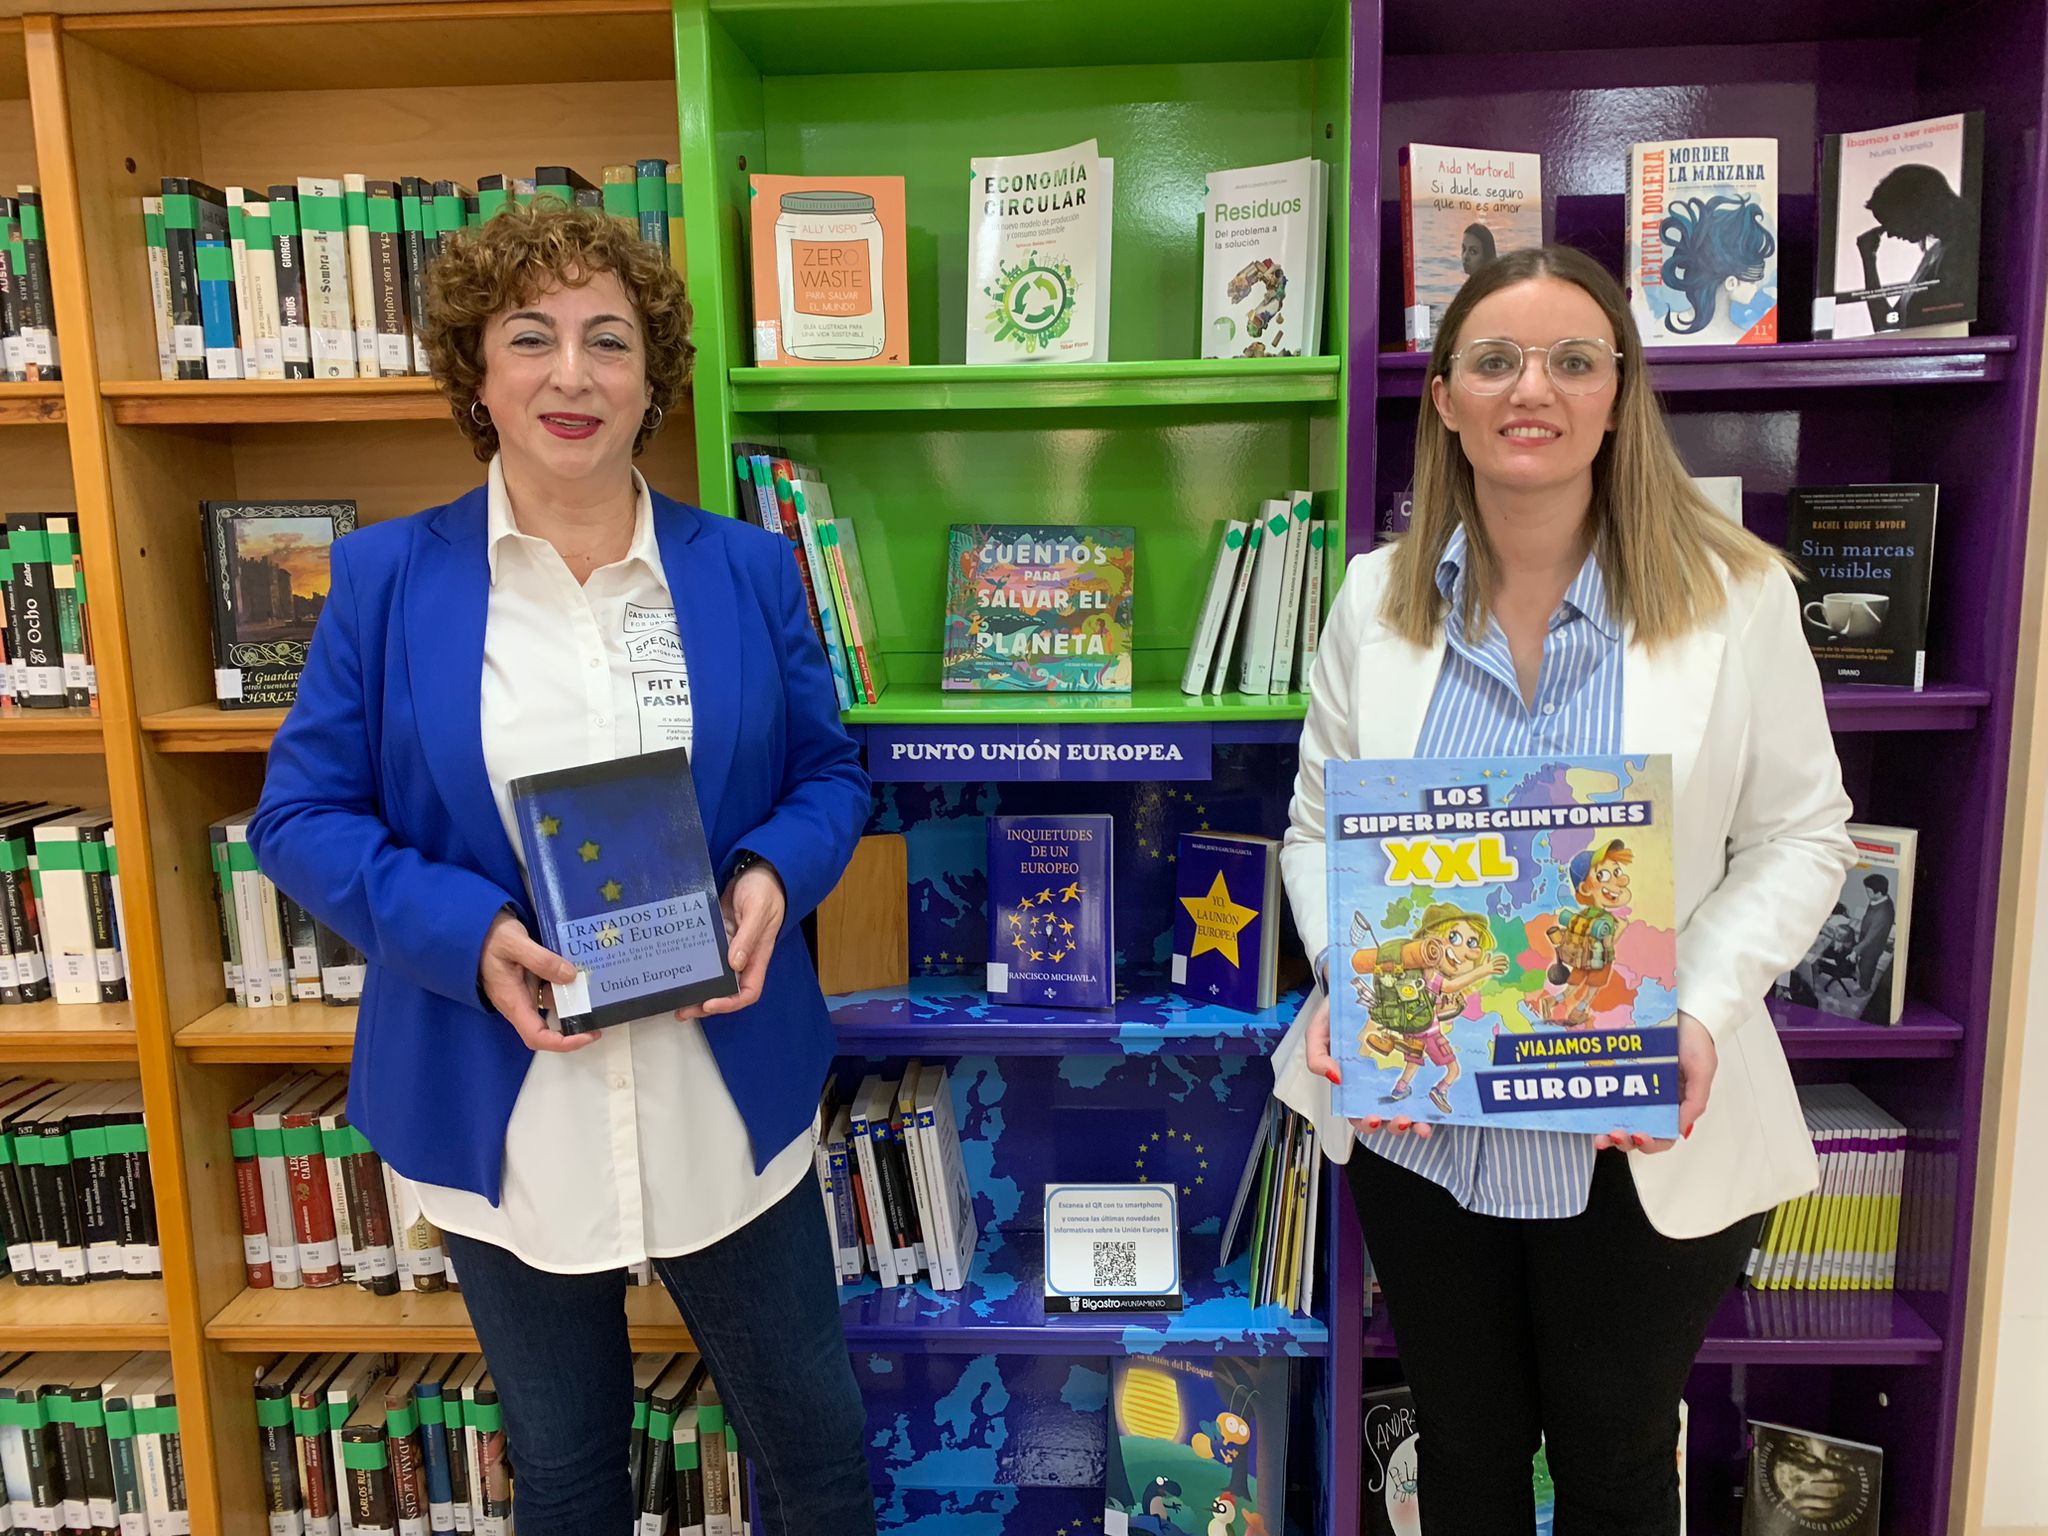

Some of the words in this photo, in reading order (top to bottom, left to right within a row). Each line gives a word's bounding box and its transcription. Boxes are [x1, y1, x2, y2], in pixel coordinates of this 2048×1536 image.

[1892, 133, 1901, 141] a
[1903, 129, 1921, 139] ser
[1923, 122, 1959, 134] reinas
[1669, 146, 1730, 165] MORDER
[1899, 141, 1934, 153] Varela
[1438, 158, 1462, 175] Aida
[1467, 162, 1515, 179] Martorell
[1669, 166, 1688, 183] LA
[1692, 164, 1766, 182] MANZANA
[985, 162, 1087, 194] ECONOMÍA
[1641, 150, 1665, 216] DOLERA
[1431, 179, 1444, 194] Si
[1485, 190, 1524, 201] seguro
[984, 187, 1086, 217] CIRCULAR
[1215, 197, 1302, 223] Residuos
[1434, 199, 1455, 213] que
[1459, 200, 1472, 211] no
[1476, 203, 1489, 212] es
[1493, 203, 1522, 213] amor
[802, 224, 825, 233] ALLY
[828, 224, 857, 233] VISPO
[1020, 219, 1041, 228] modelo
[1042, 218, 1050, 226] de
[1051, 214, 1080, 227] producción
[1011, 230, 1037, 239] consumo
[1038, 226, 1065, 237] sostenible
[1215, 229, 1229, 239] Del
[1231, 225, 1270, 239] problema
[1215, 241, 1223, 250] la
[1224, 238, 1260, 249] solución
[1641, 218, 1664, 287] LETICIA
[382, 252, 391, 266] DE
[803, 249, 860, 266] ZERO
[319, 253, 332, 293] Sombra
[383, 268, 393, 284] LOS
[801, 271, 863, 288] WASTE
[806, 292, 826, 300] PARA
[828, 292, 858, 300] SALVAR
[286, 296, 296, 317] DIOS
[809, 303, 820, 312] EL
[822, 303, 856, 311] MUNDO
[1812, 520, 1840, 530] RACHEL
[1844, 520, 1871, 530] LOUISE
[1875, 520, 1907, 530] SNYDER
[979, 544, 1108, 565] CUENTOS
[1801, 539, 1834, 557] Sin
[1842, 544, 1915, 558] marcas
[1024, 571, 1061, 582] PARA
[1819, 562, 1893, 580] visibles
[977, 588, 1070, 609] SALVAR
[1079, 590, 1108, 610] EL
[23, 598, 42, 644] Ocho
[628, 610, 661, 619] CASUAL
[976, 632, 1105, 655] PLANETA
[30, 649, 47, 664] El
[240, 672, 253, 683] El
[648, 679, 673, 691] FIT
[643, 694, 689, 707] FASH
[891, 743, 975, 760] PUNTO
[981, 739, 1061, 761] UNIÓN
[1067, 744, 1183, 761] EUROPEA
[1433, 787, 1483, 806] LOS
[1343, 804, 1645, 835] SUPERPREGUNTONES
[1007, 829, 1093, 843] INQUIETUDES
[1031, 846, 1047, 857] DE
[1050, 846, 1069, 857] UN
[1385, 837, 1513, 883] XXL
[1021, 862, 1079, 874] EUROPEO
[7, 884, 16, 907] Muerte
[14, 926, 23, 946] Fenice
[566, 910, 652, 938] TRATADOS
[657, 904, 678, 918] DE
[682, 899, 703, 913] LA
[1197, 909, 1208, 919] LA
[1209, 911, 1239, 925] UNIÓN
[567, 933, 625, 956] UNIÓN
[630, 915, 706, 942] EUROPEA
[1197, 925, 1237, 941] EUROPEA
[600, 975, 640, 993] Unión
[642, 964, 692, 983] Europea
[1051, 973, 1097, 983] MICHAVILA
[1515, 1037, 1602, 1063] ¡VIAJAMOS
[1606, 1035, 1642, 1052] POR
[1492, 1073, 1660, 1101] EUROPA!
[43, 1126, 60, 1135] 408
[1058, 1201, 1084, 1209] Escanea
[1085, 1201, 1092, 1209] el
[1125, 1202, 1163, 1210] smartphone
[1142, 1227, 1169, 1235] Europea
[1082, 1298, 1121, 1310] Bigastro
[1120, 1299, 1166, 1307] AYUNTAMIENTO
[1171, 1359, 1184, 1371] del
[1186, 1361, 1214, 1378] Bosque
[268, 1427, 276, 1451] CHICOT
[271, 1461, 280, 1472] LA
[401, 1445, 413, 1483] DAMA
[357, 1484, 370, 1517] CARLOS
